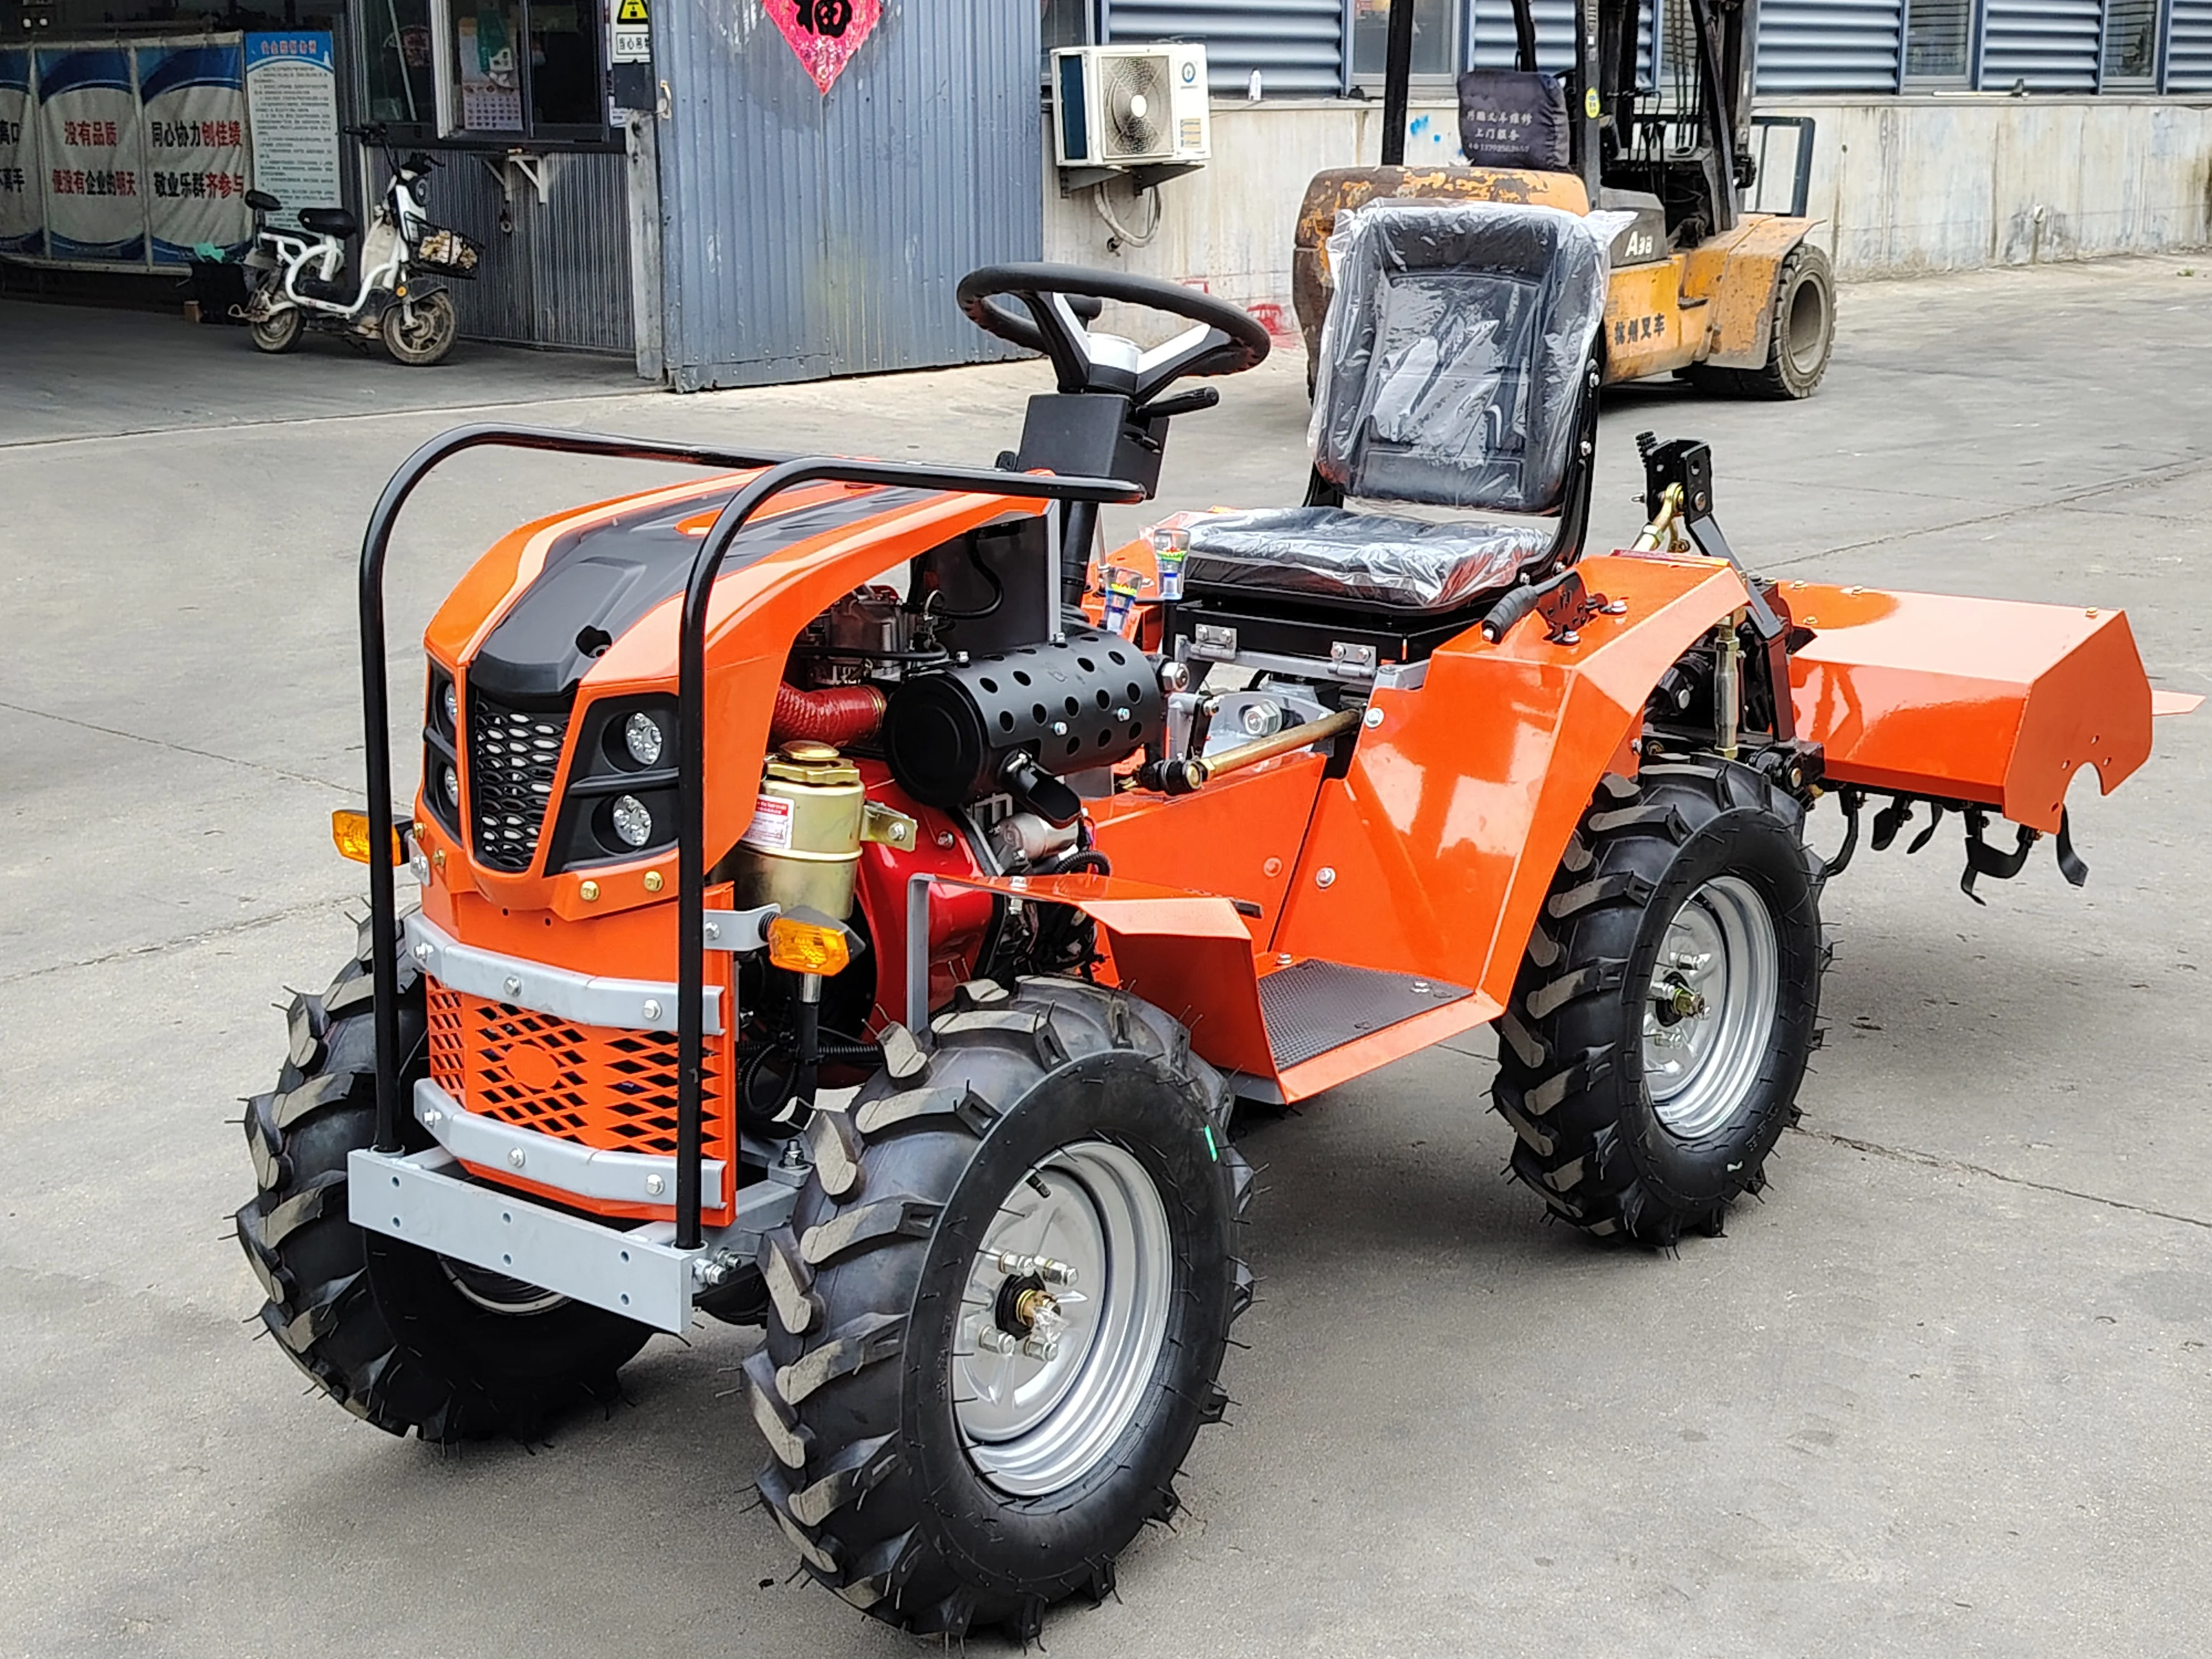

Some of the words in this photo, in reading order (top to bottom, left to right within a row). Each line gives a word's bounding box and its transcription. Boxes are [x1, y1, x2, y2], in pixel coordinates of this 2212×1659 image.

[65, 120, 117, 147] 没有品质
[152, 120, 243, 148] 同心协力创佳绩
[53, 169, 137, 195] 便没有企业的明天
[154, 171, 244, 199] 敬业乐群齐参与
[1614, 312, 1665, 346] 杭州叉车
